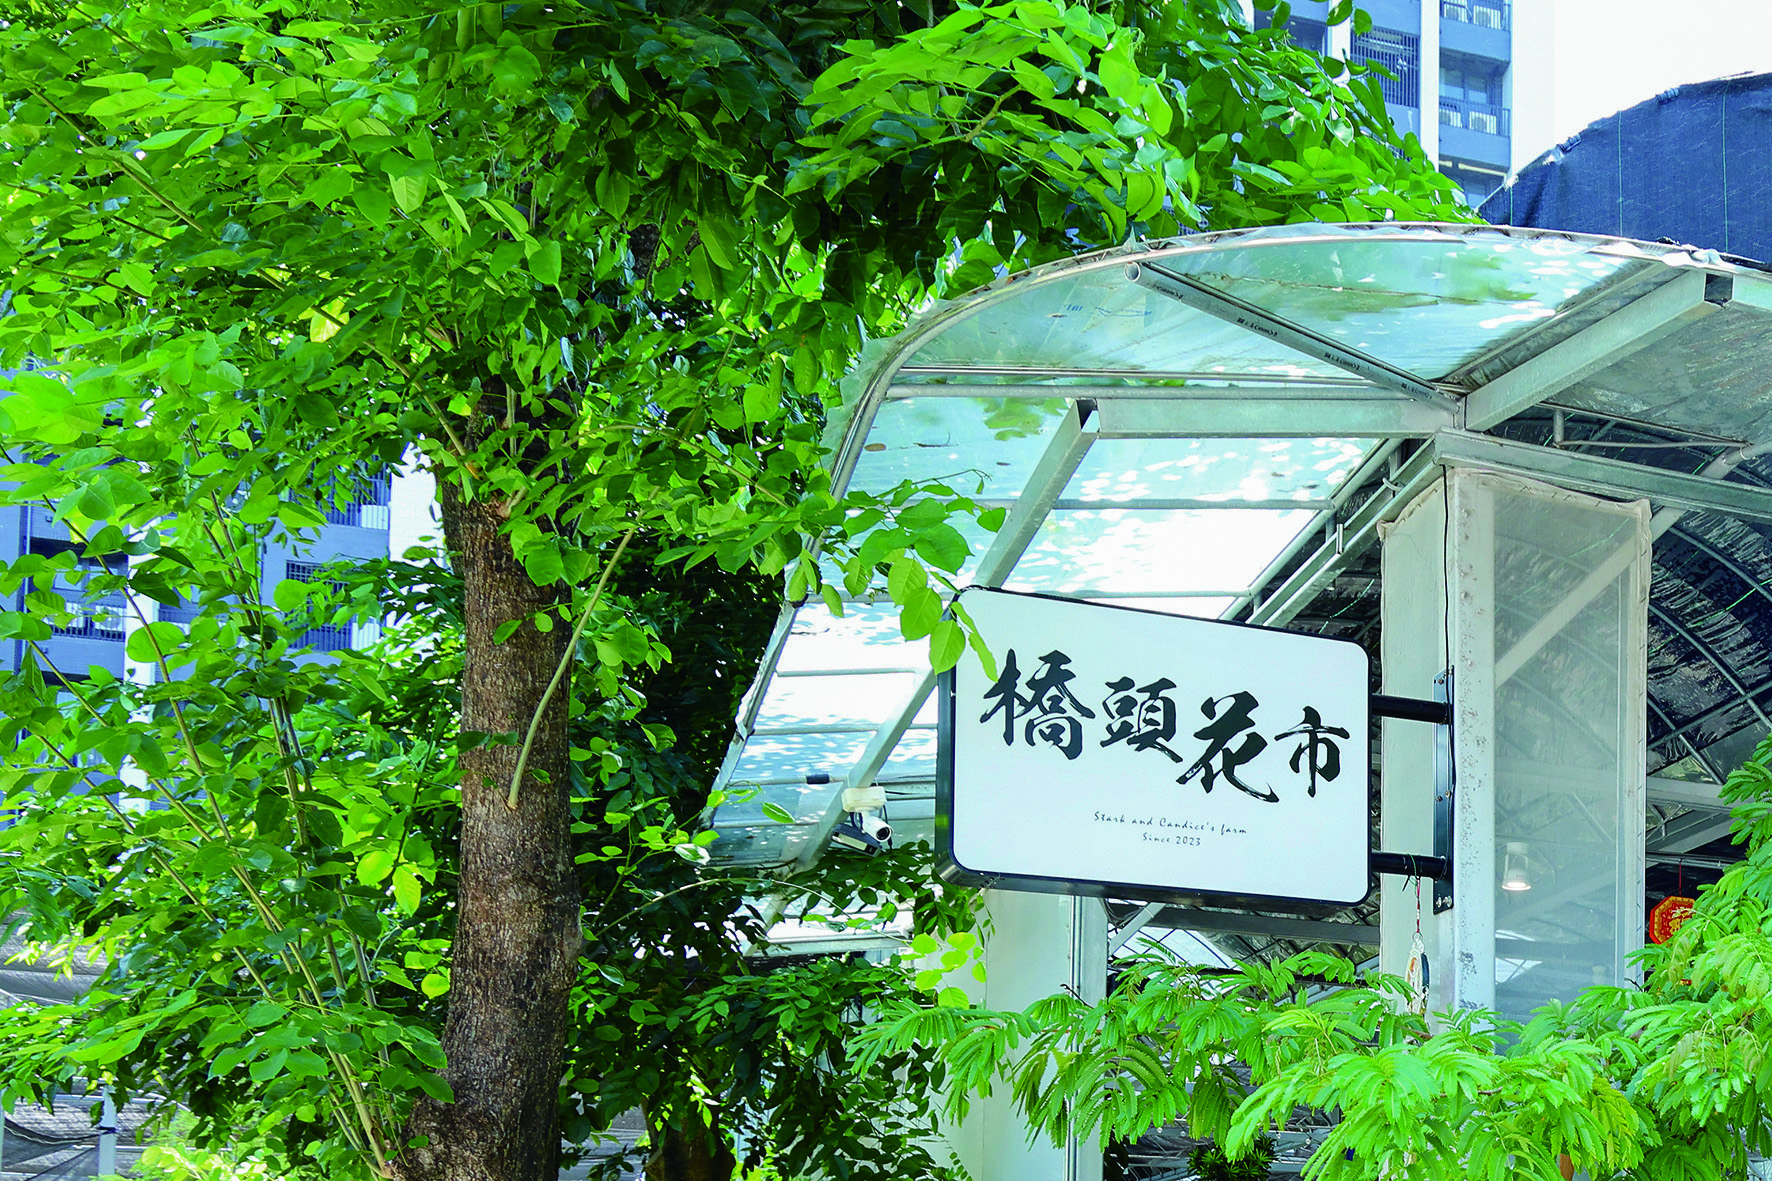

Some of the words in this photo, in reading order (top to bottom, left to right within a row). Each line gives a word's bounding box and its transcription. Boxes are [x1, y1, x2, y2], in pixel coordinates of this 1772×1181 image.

[980, 649, 1350, 803] 橋頭花市
[1094, 811, 1125, 823] Stark
[1132, 817, 1153, 825] and
[1159, 817, 1215, 832] Candice's
[1221, 824, 1248, 835] farm
[1142, 832, 1170, 843] Since
[1176, 835, 1201, 846] 2023
